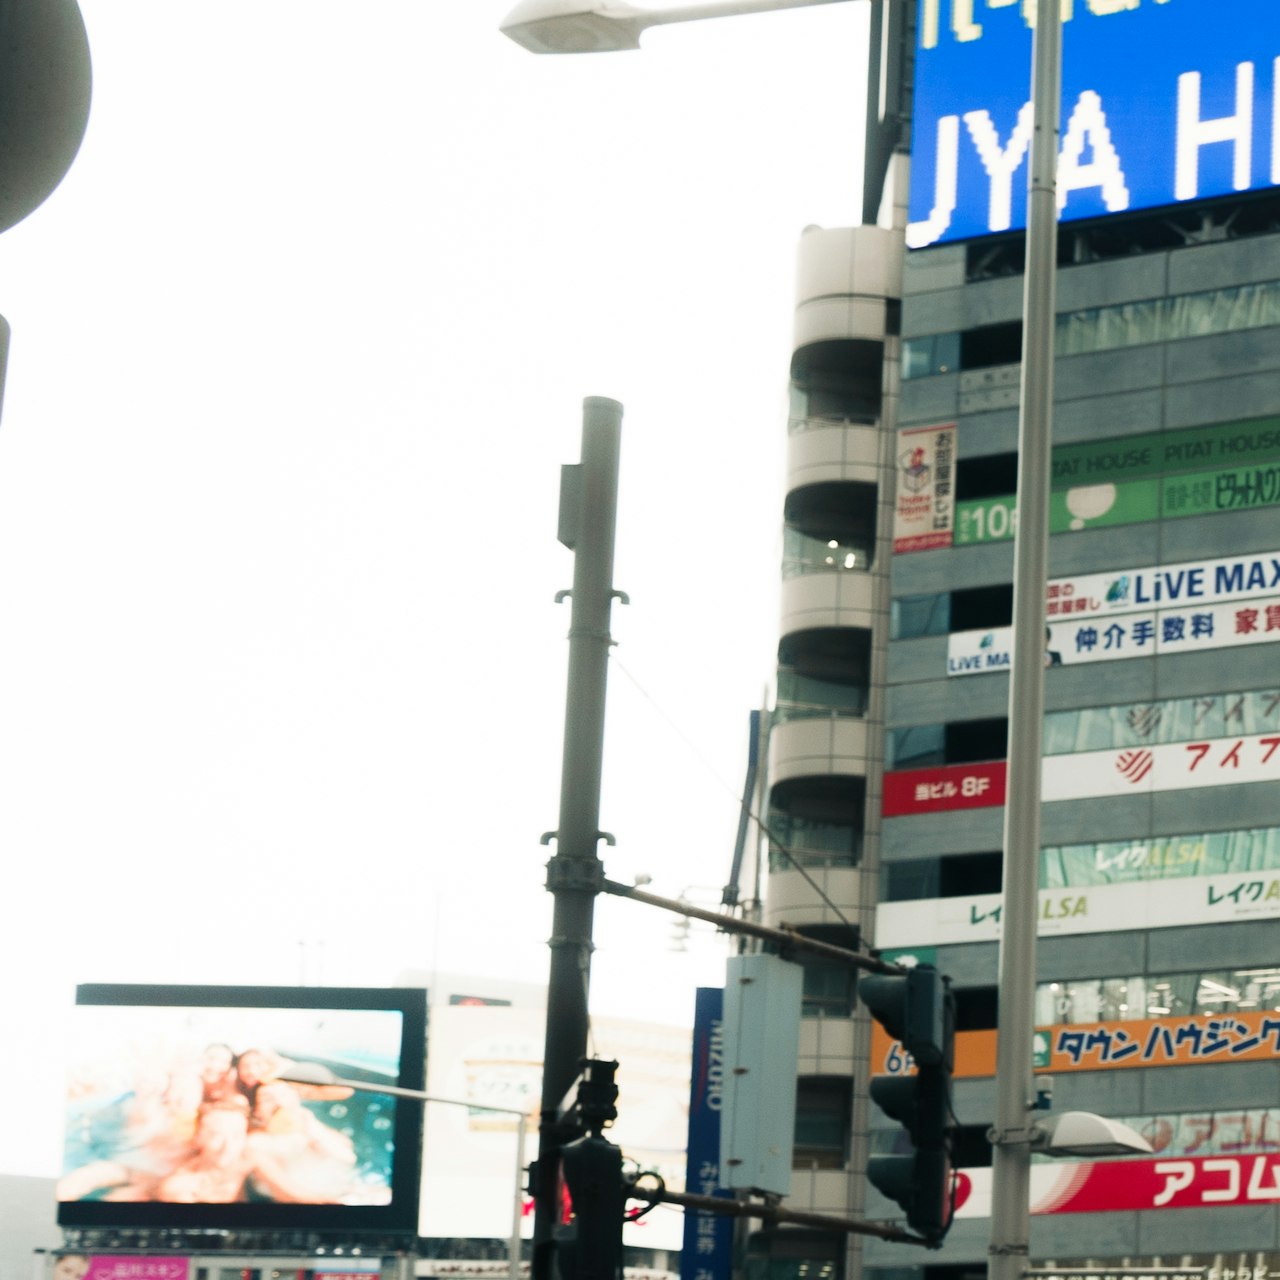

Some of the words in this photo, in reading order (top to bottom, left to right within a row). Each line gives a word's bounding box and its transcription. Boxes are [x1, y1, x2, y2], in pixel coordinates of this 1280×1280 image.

[1052, 459, 1080, 479] TAT
[1087, 447, 1151, 472] HOUSE
[1164, 443, 1214, 463] PITAT
[1134, 567, 1205, 604] LiVE
[1075, 612, 1216, 654] 仲介手数料
[985, 652, 1012, 670] MA
[960, 776, 991, 798] 8F
